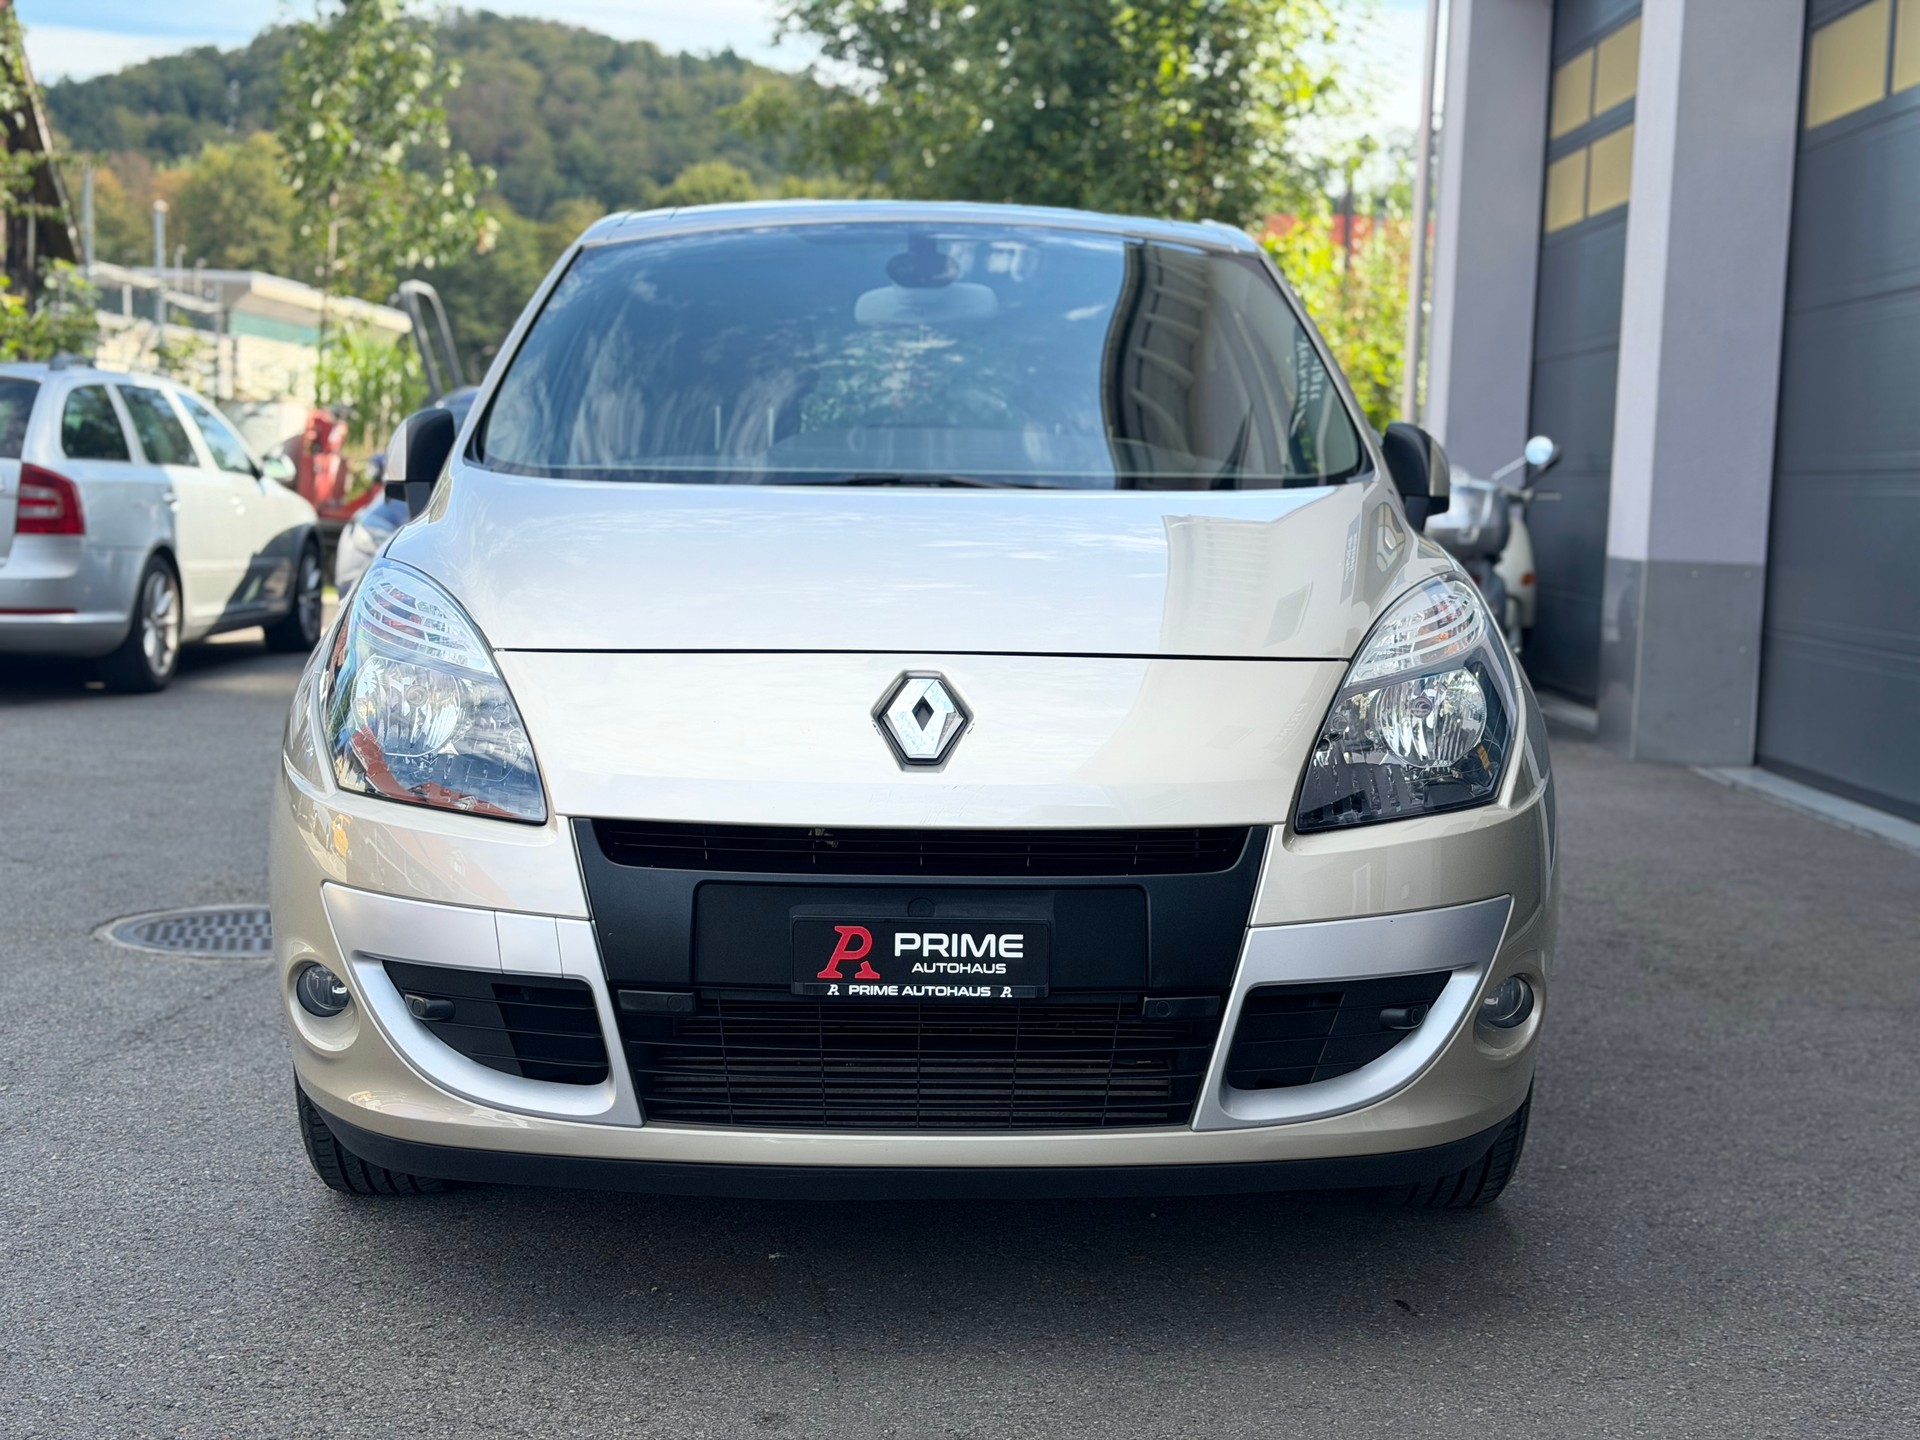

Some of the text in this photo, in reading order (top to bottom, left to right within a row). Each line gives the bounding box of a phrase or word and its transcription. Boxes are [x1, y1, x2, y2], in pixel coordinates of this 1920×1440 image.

[894, 932, 1024, 959] PRIME
[911, 962, 1007, 975] AUTOHAUS
[848, 984, 899, 996] PRIME
[901, 985, 992, 997] AUTOHAUS
